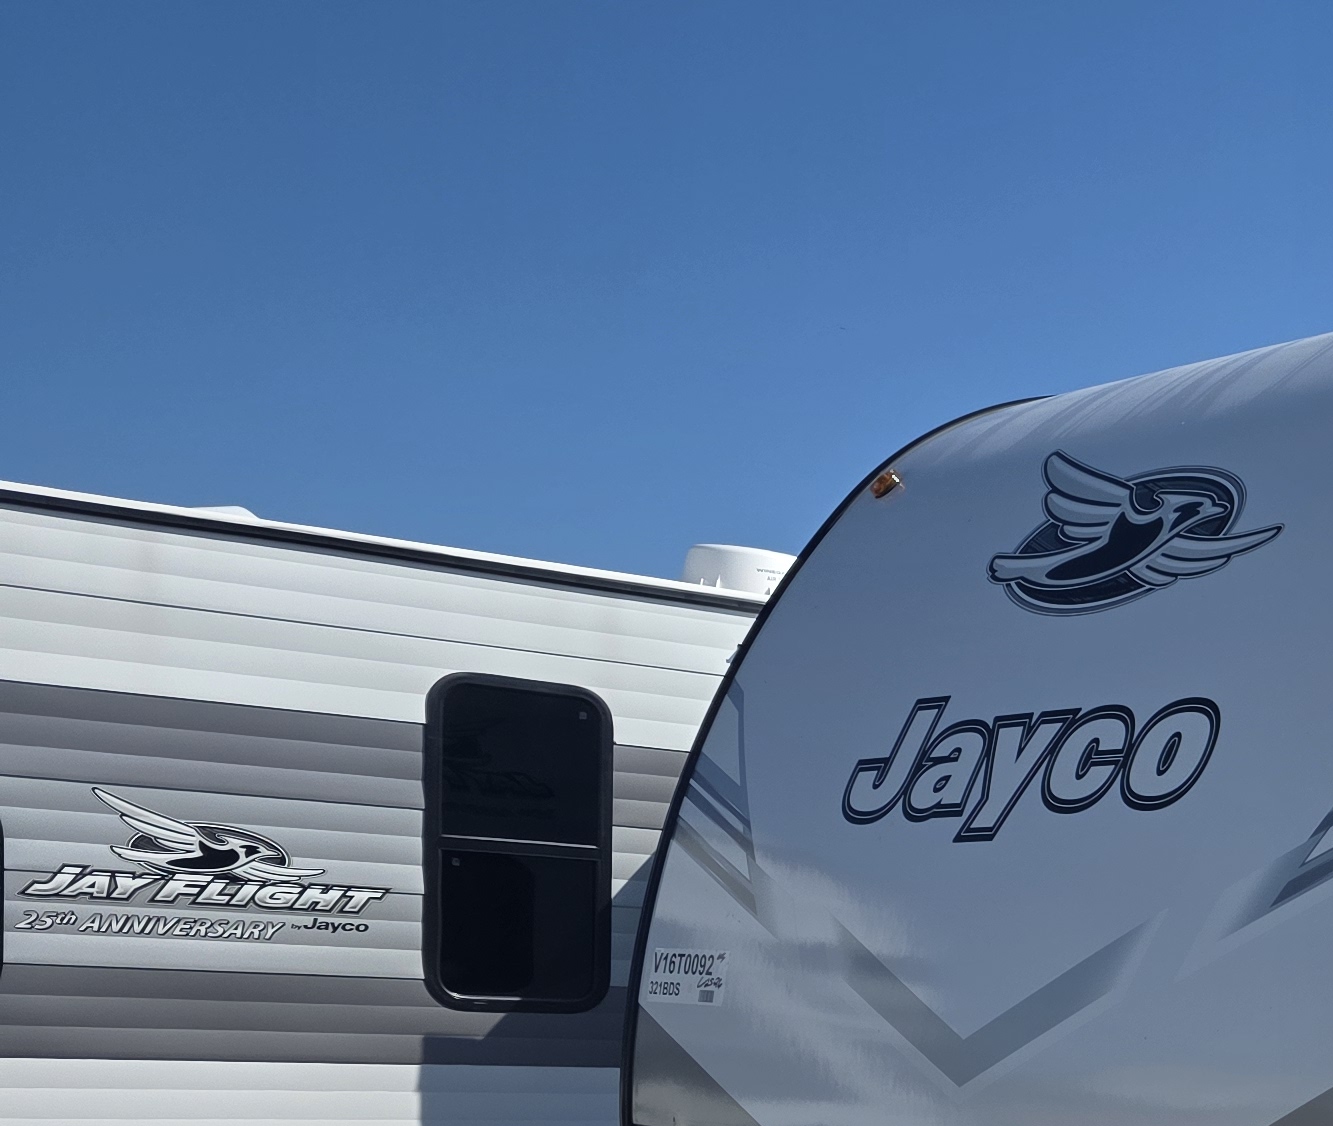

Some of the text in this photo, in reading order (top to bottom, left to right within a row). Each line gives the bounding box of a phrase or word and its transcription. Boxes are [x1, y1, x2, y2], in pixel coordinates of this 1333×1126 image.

[842, 695, 1221, 843] Jayco
[14, 863, 392, 916] JAY FLIGHT
[15, 910, 77, 931] 25th
[78, 912, 286, 940] ANNIVERSARY
[303, 917, 369, 934] Jayco
[654, 951, 714, 976] V16T0092
[648, 980, 681, 997] 321BDS
